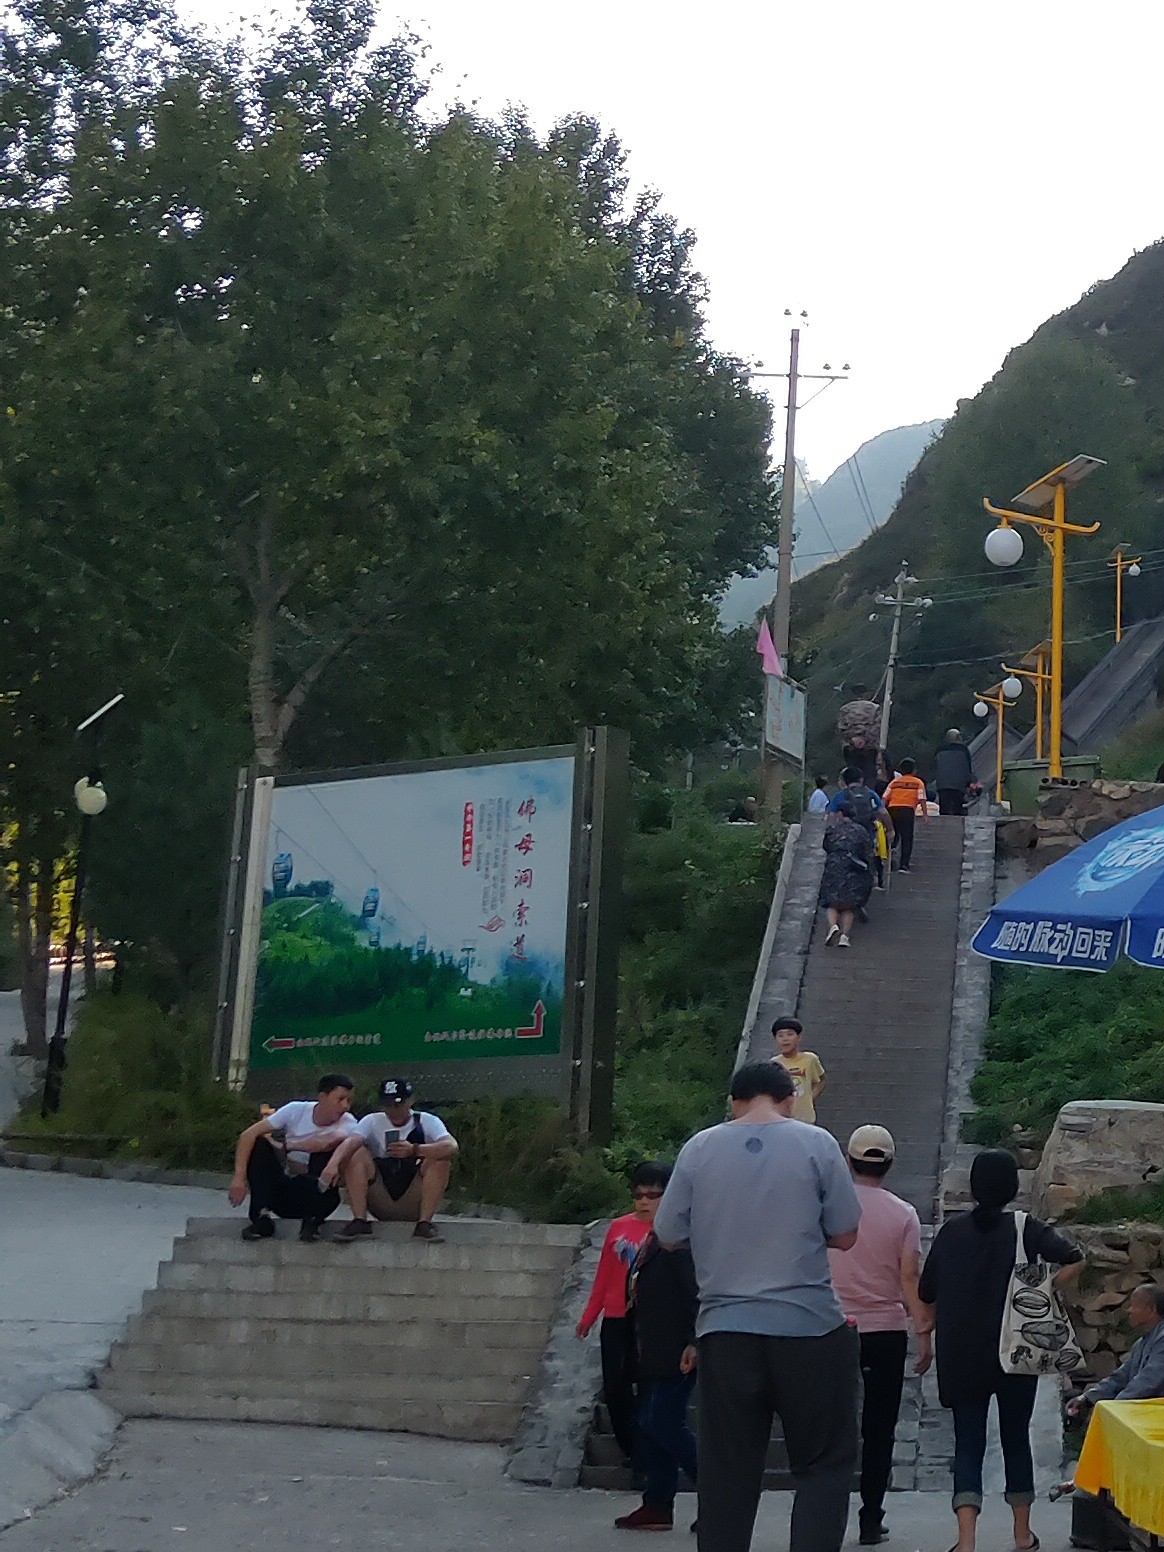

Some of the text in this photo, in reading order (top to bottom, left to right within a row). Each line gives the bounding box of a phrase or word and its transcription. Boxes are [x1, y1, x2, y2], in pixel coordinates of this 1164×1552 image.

[991, 920, 1114, 963] 随时脉动回来
